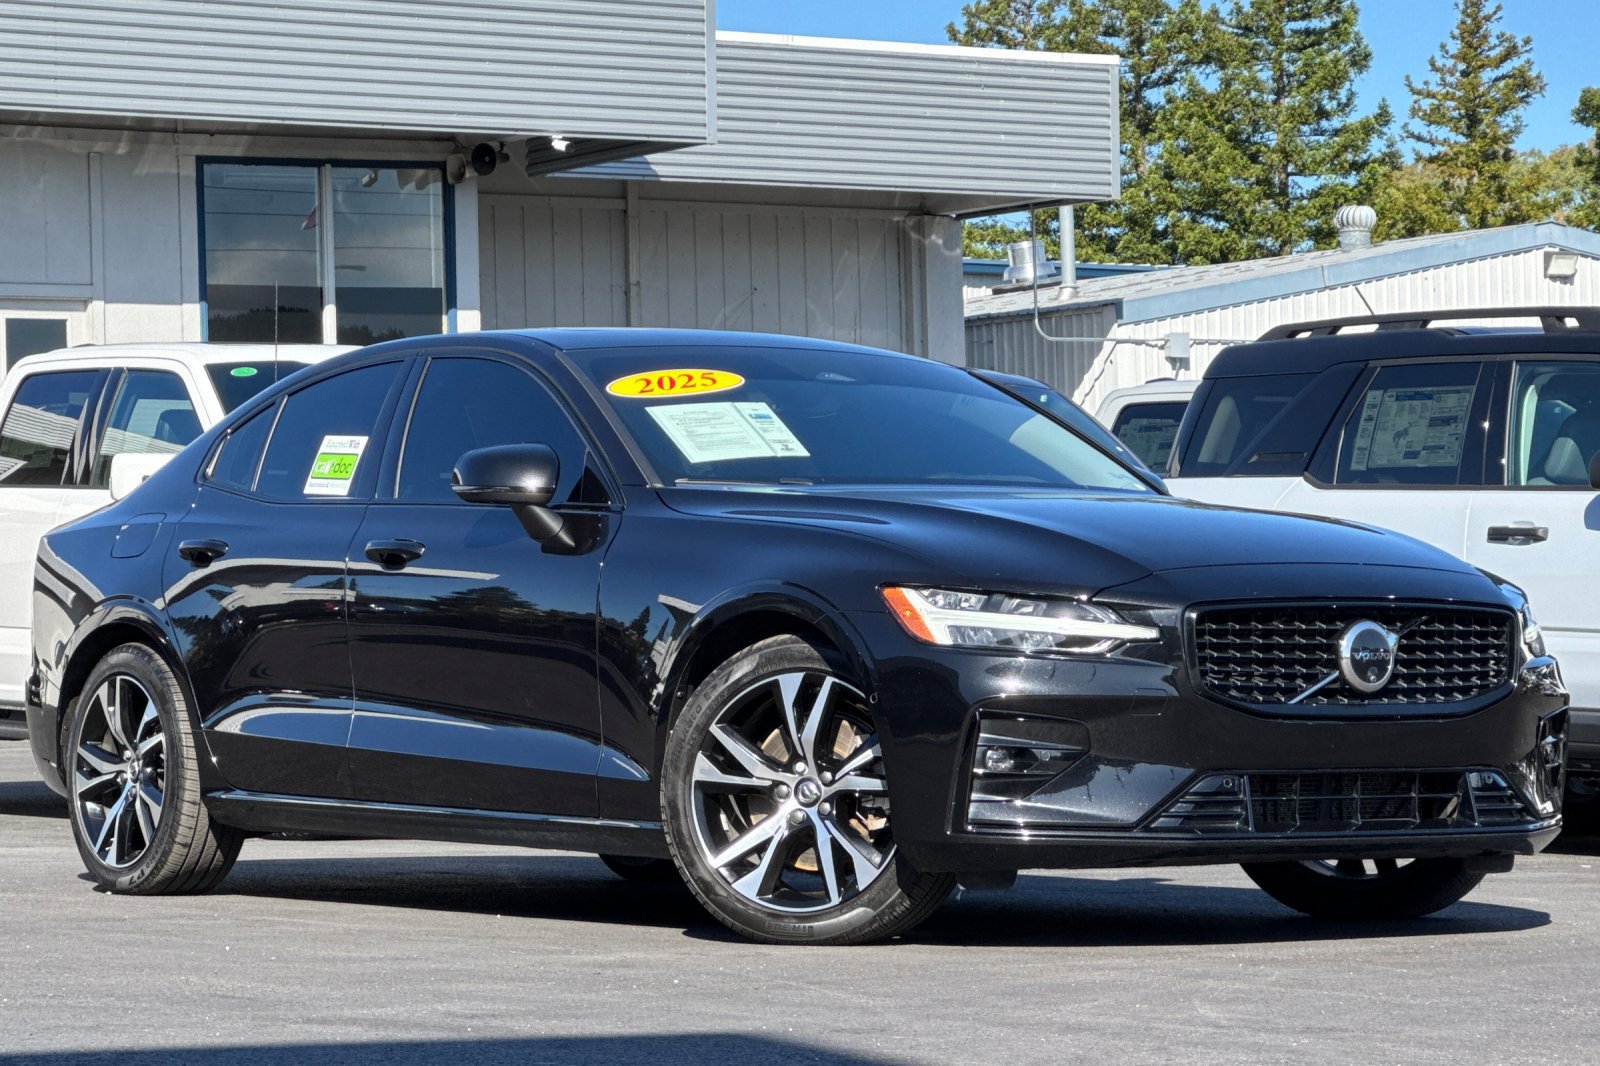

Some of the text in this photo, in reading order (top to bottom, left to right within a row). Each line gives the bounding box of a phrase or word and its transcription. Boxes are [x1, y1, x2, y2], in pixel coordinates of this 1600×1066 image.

[635, 372, 717, 394] 2025
[1351, 651, 1390, 660] VOLVO
[128, 868, 146, 887] P7
